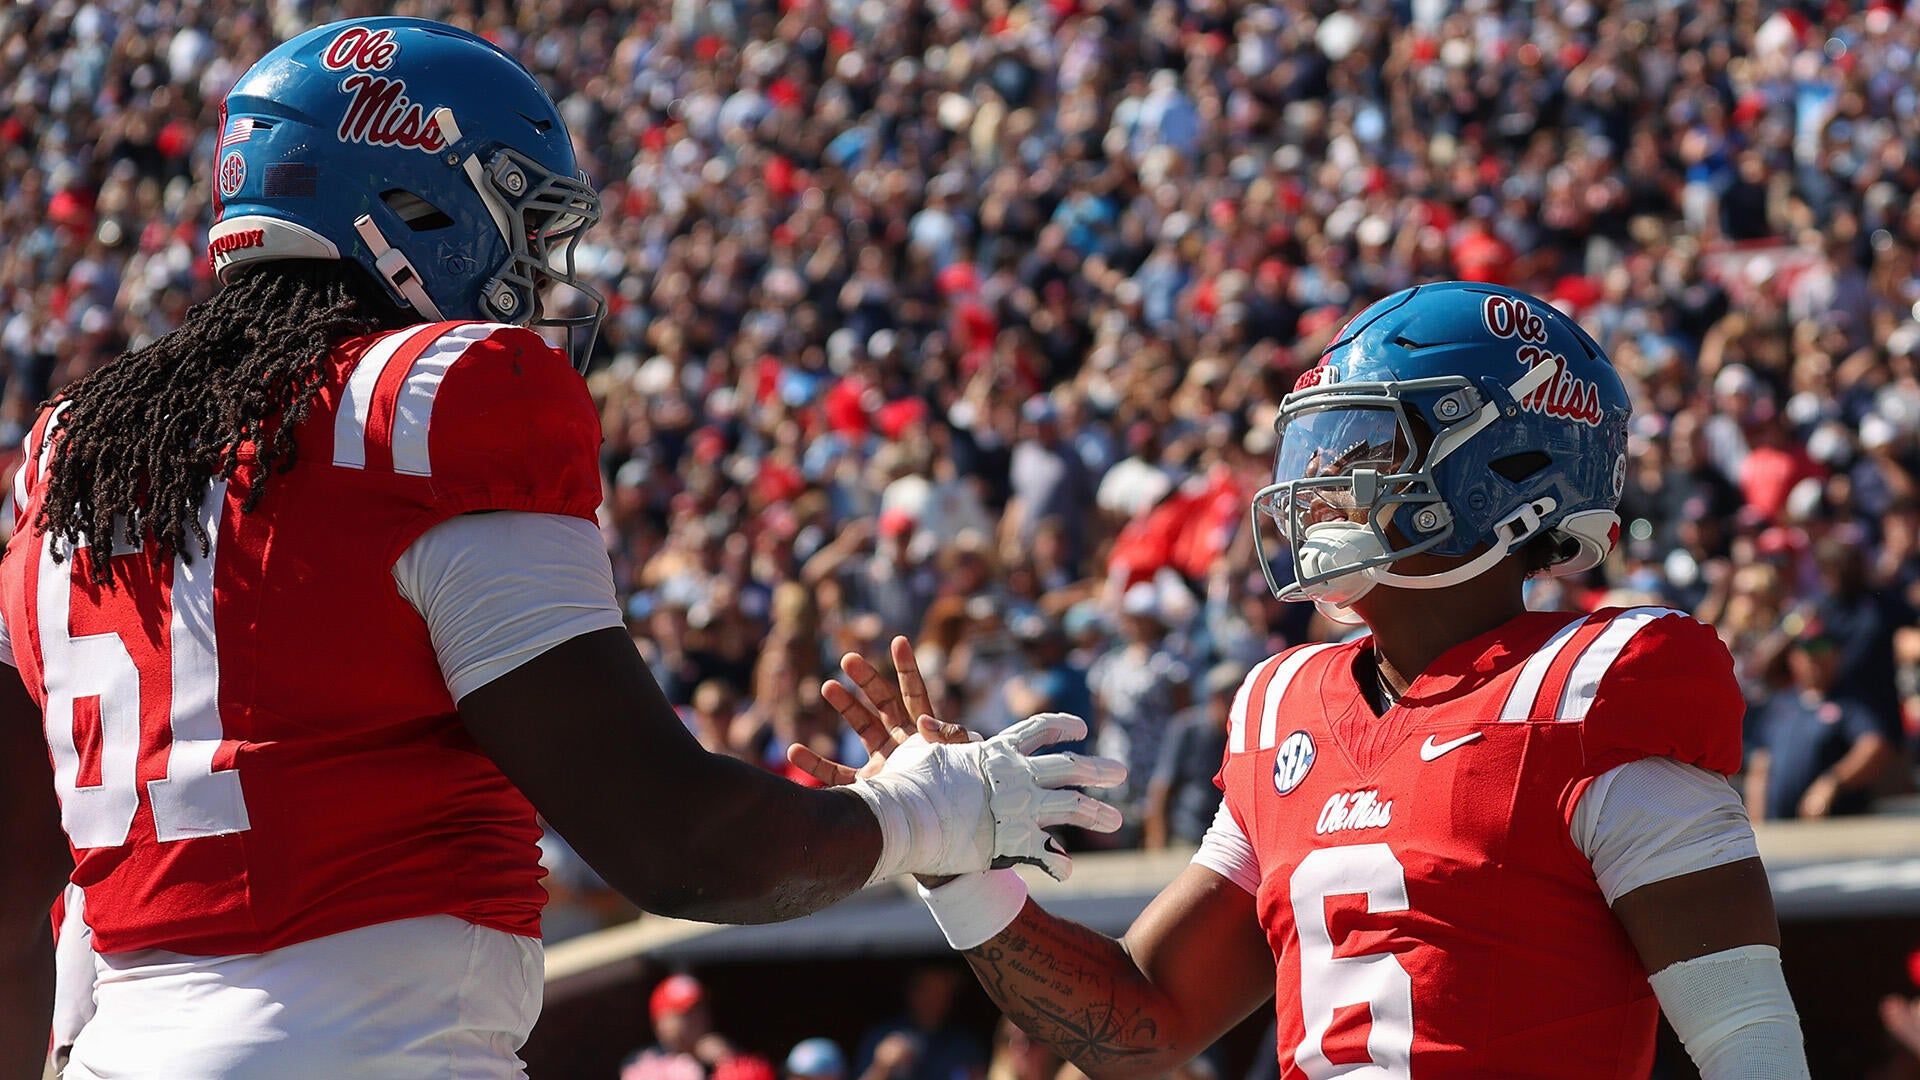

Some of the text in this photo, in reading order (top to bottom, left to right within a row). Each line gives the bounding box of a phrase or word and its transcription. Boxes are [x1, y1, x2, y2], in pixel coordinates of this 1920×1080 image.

[322, 26, 398, 73] Ole
[337, 73, 449, 155] Miss
[220, 151, 247, 197] SEC
[1484, 295, 1548, 344] Ole
[1516, 344, 1604, 427] Miss
[37, 478, 251, 849] 61
[1274, 730, 1316, 796] SEC
[1290, 843, 1414, 1080] 6
